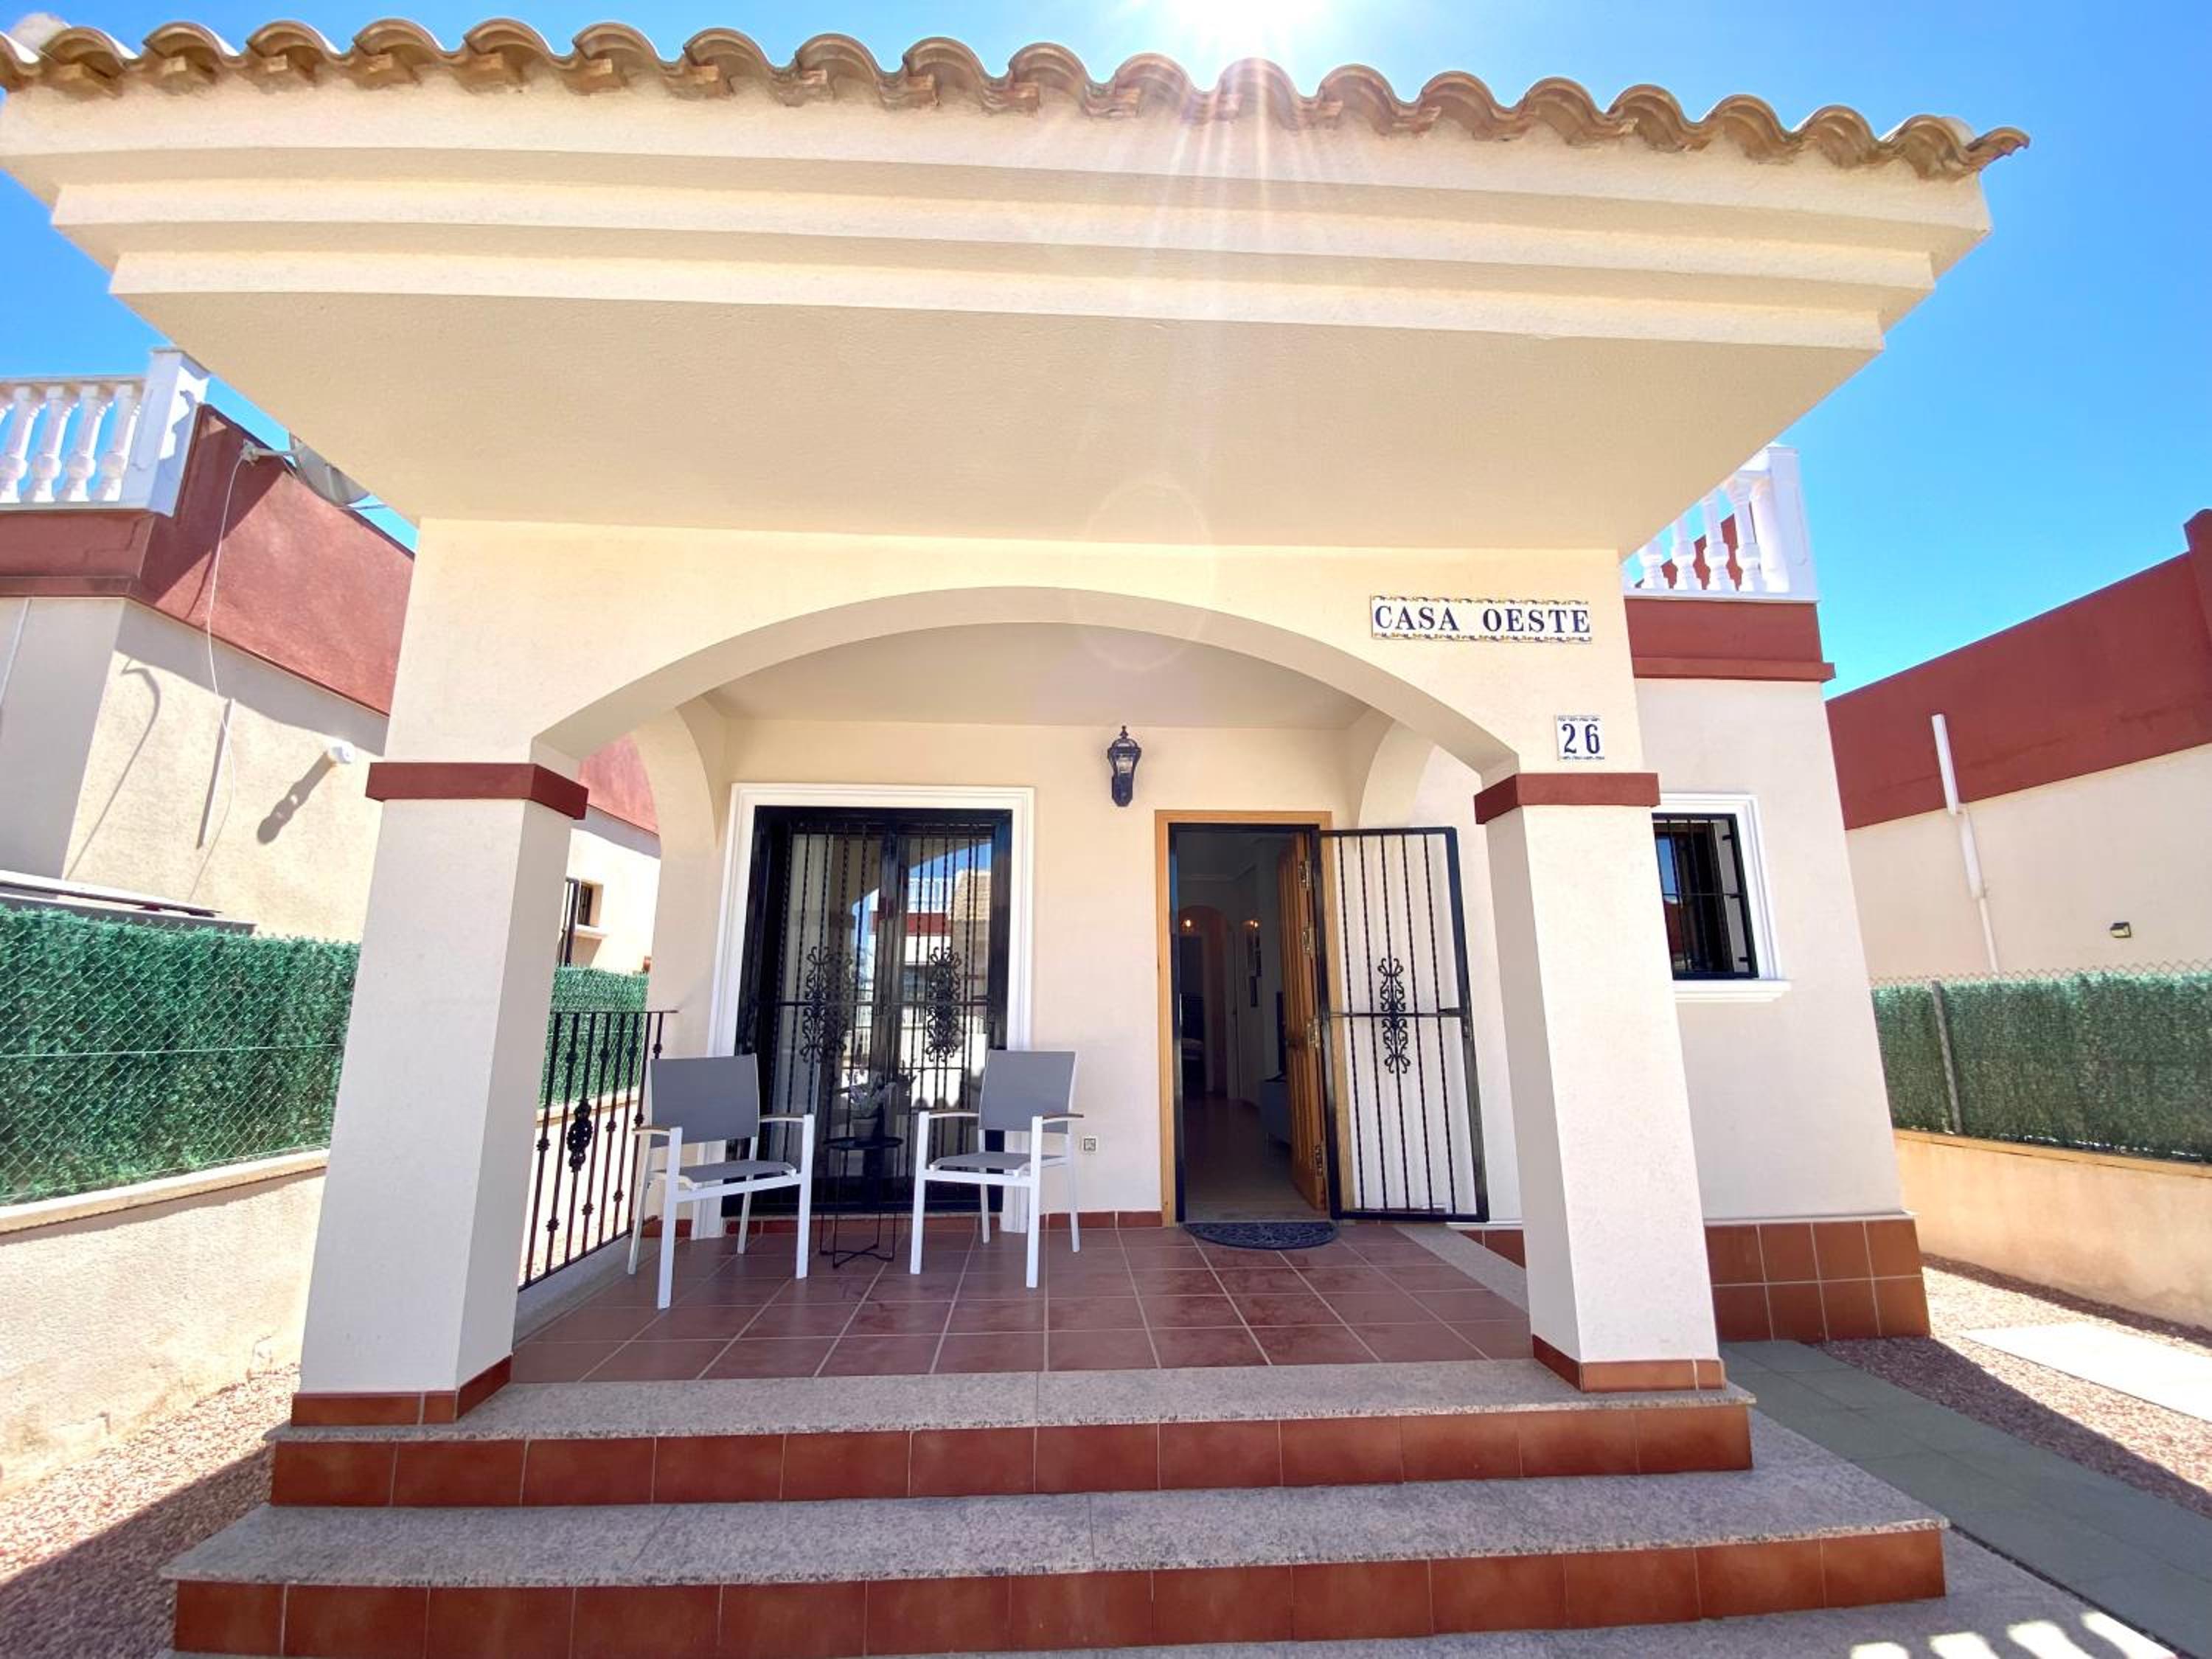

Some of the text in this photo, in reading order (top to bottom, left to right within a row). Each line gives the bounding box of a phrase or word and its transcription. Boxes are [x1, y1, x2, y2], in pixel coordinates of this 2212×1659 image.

[1374, 605, 1590, 633] CASA OESTE
[1562, 723, 1600, 754] 26
